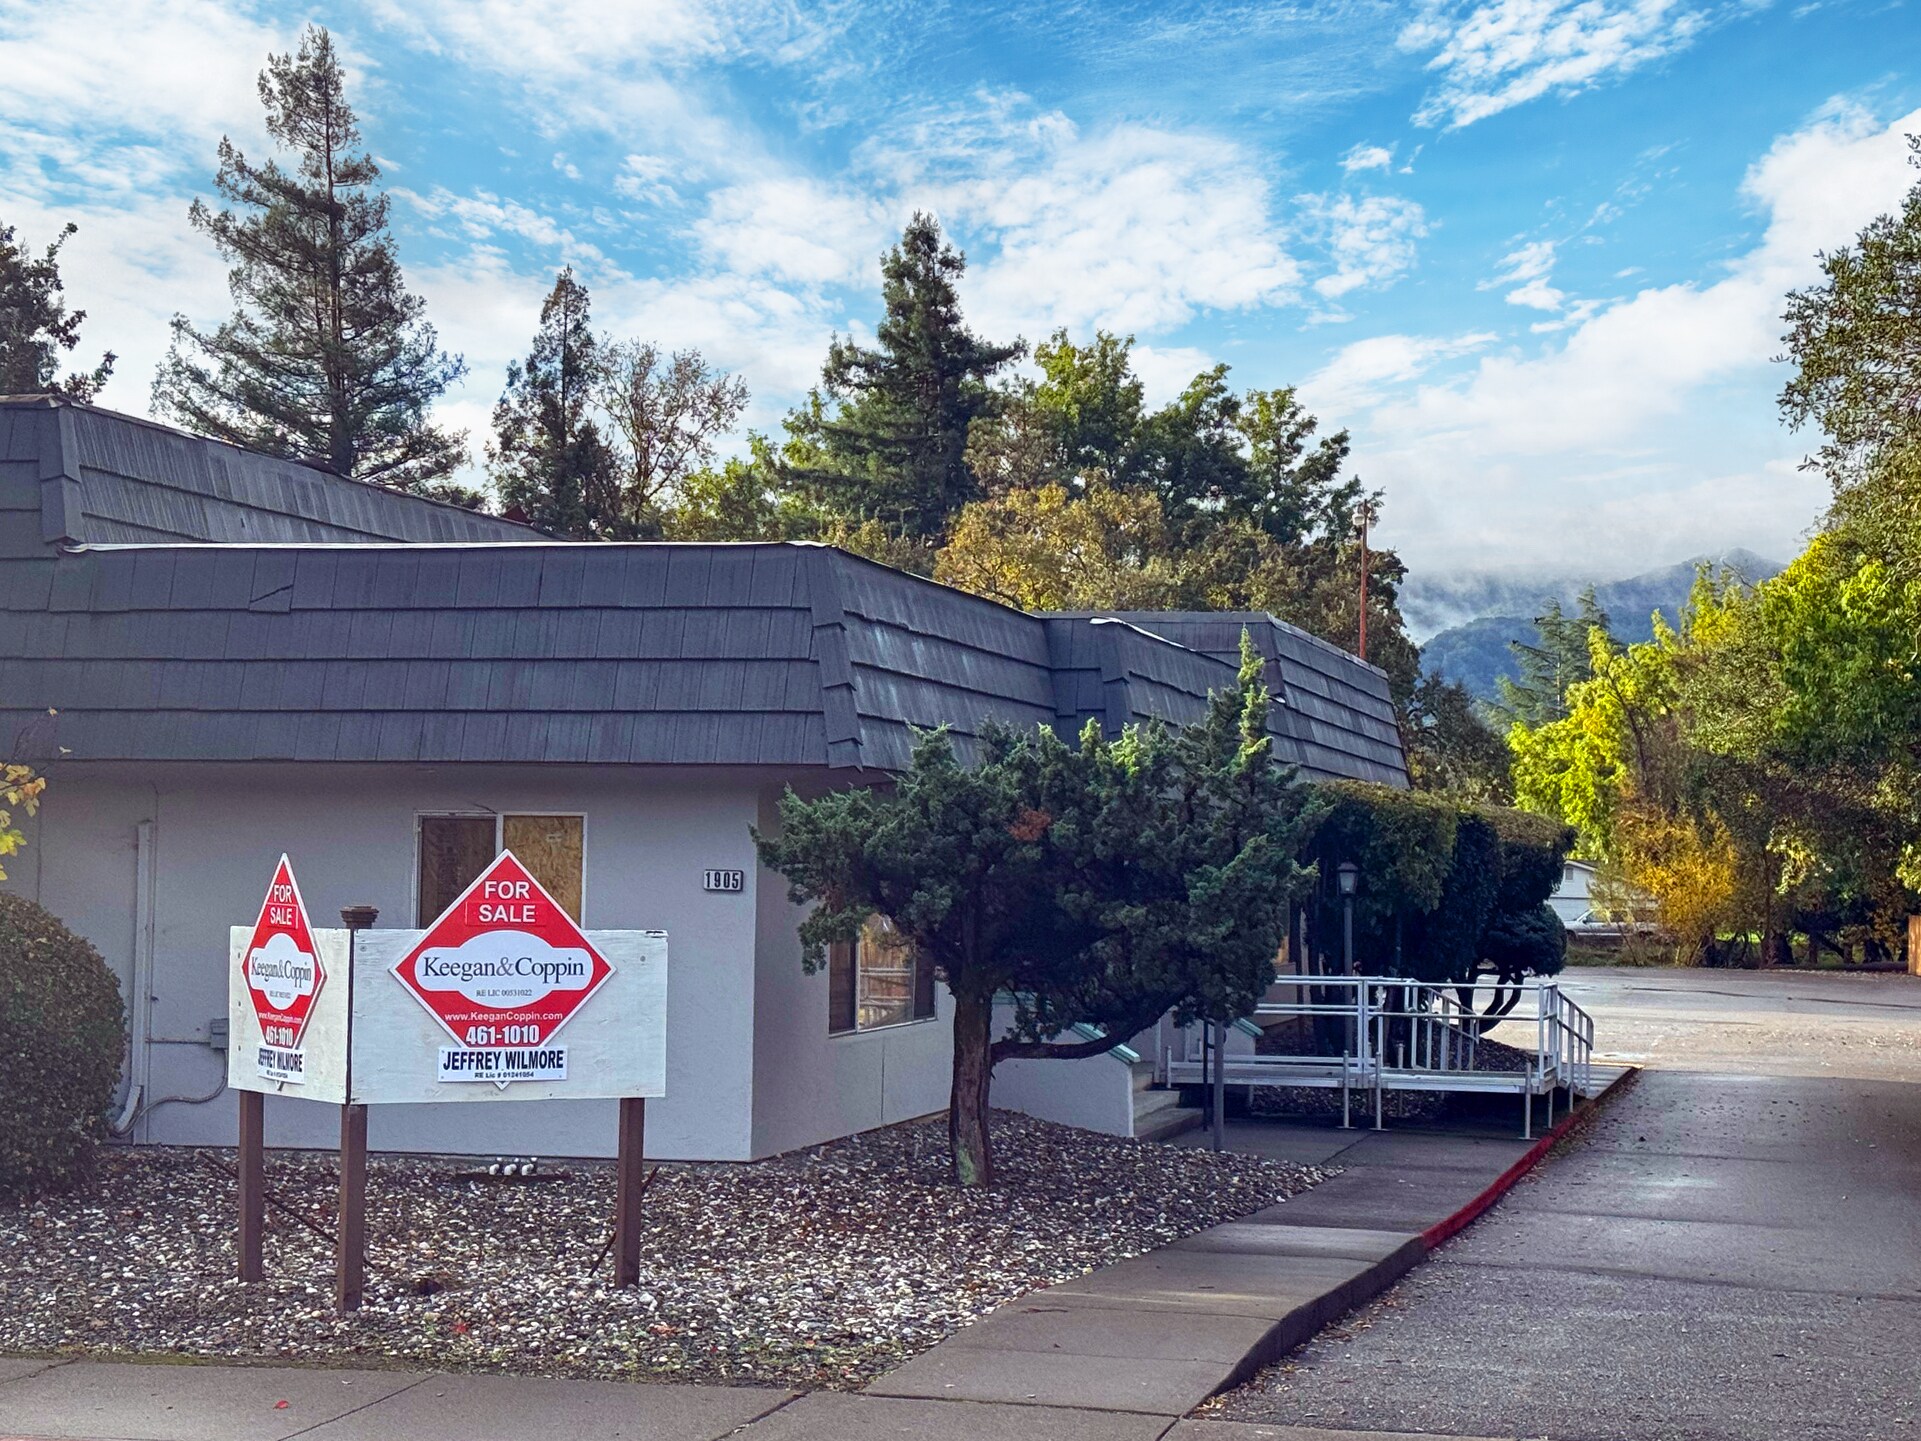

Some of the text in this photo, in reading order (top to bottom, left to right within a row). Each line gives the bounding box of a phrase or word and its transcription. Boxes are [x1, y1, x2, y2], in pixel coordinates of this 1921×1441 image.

[705, 871, 740, 889] 1905
[273, 884, 293, 903] FOR
[484, 881, 530, 900] FOR
[270, 907, 293, 926] SALE
[478, 904, 536, 923] SALE
[251, 956, 312, 988] Keegan&Coppin
[423, 956, 585, 984] Keegan&Coppin
[476, 989, 487, 998] RE
[487, 989, 501, 997] LIC
[444, 1011, 563, 1023] www.KeeganCoppin.com
[265, 1025, 294, 1046] 461-1010
[465, 1025, 540, 1045] 461-1010
[258, 1047, 304, 1073] JEFFREY WILMORE
[442, 1049, 564, 1071] JEFFREY WILMORE
